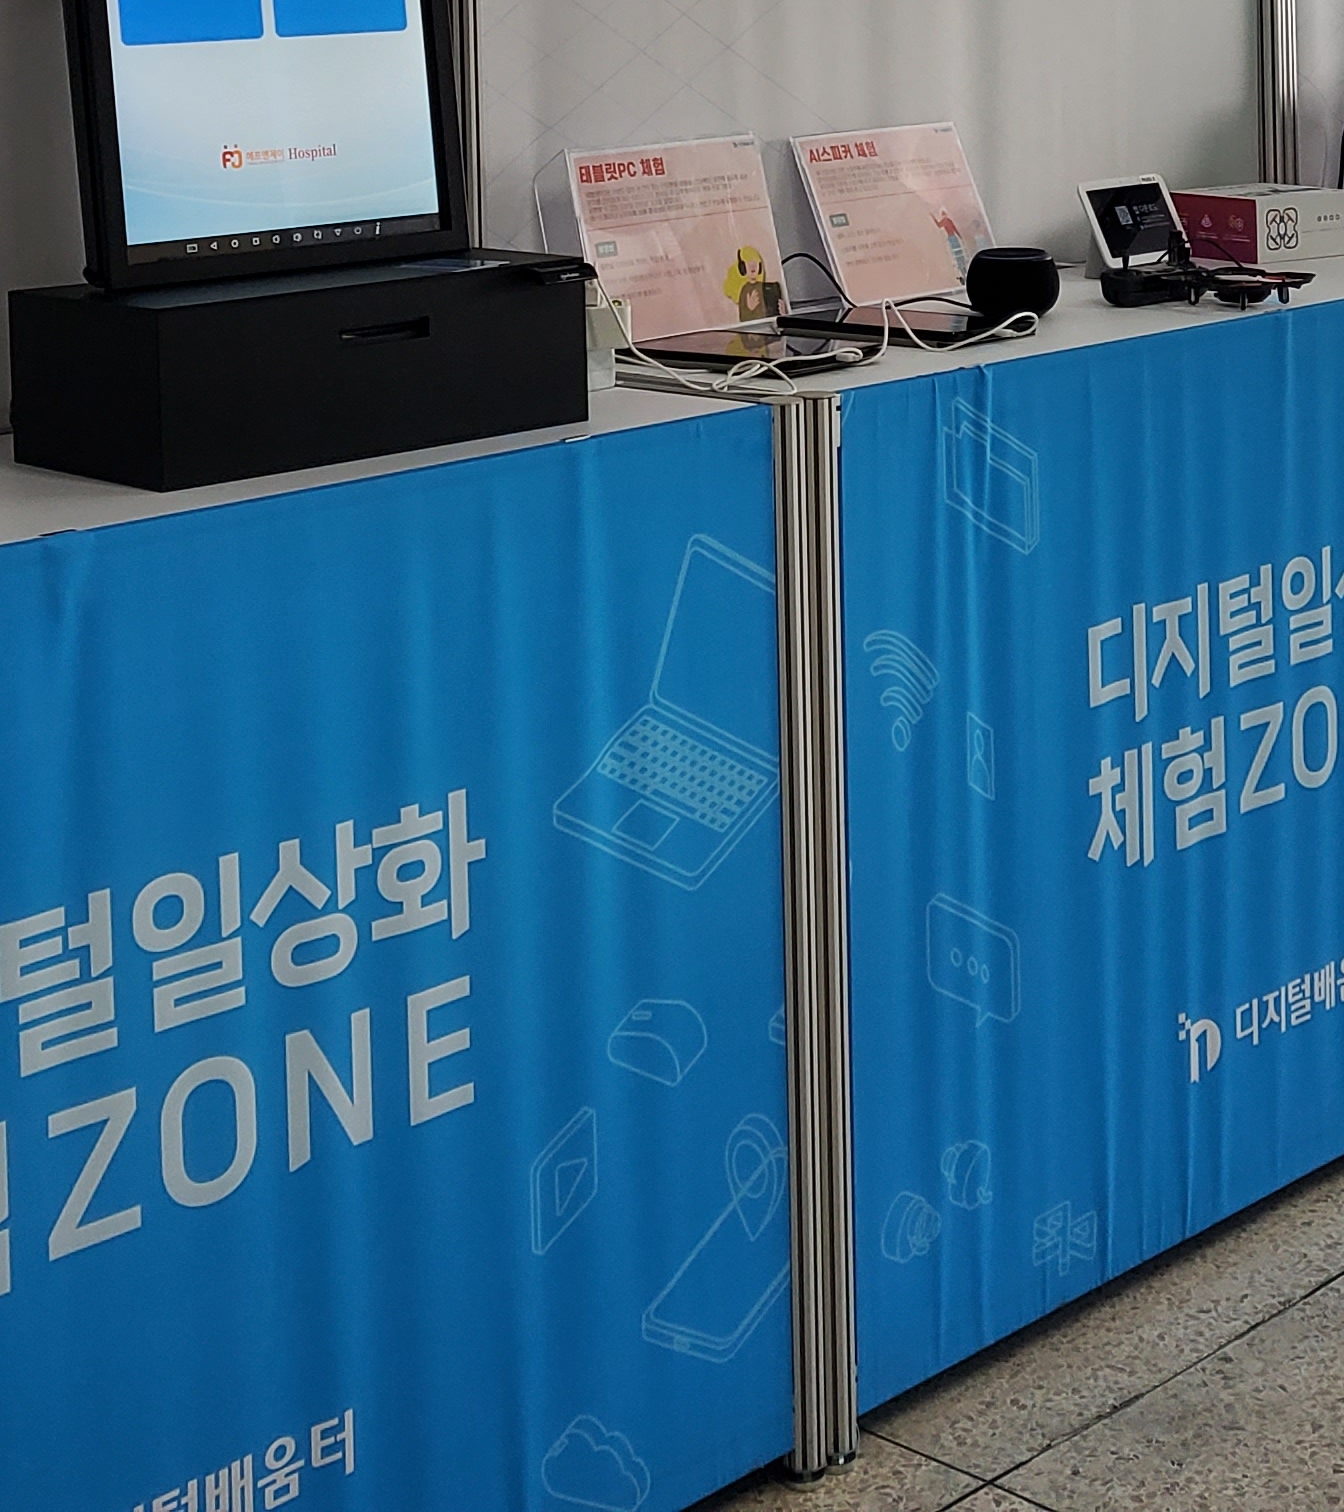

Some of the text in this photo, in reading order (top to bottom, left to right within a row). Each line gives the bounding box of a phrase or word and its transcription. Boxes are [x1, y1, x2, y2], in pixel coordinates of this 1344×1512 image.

[288, 144, 336, 162] Hospital
[809, 140, 879, 164] AI스피커 체험
[579, 157, 666, 184] 태블릿PC 체험
